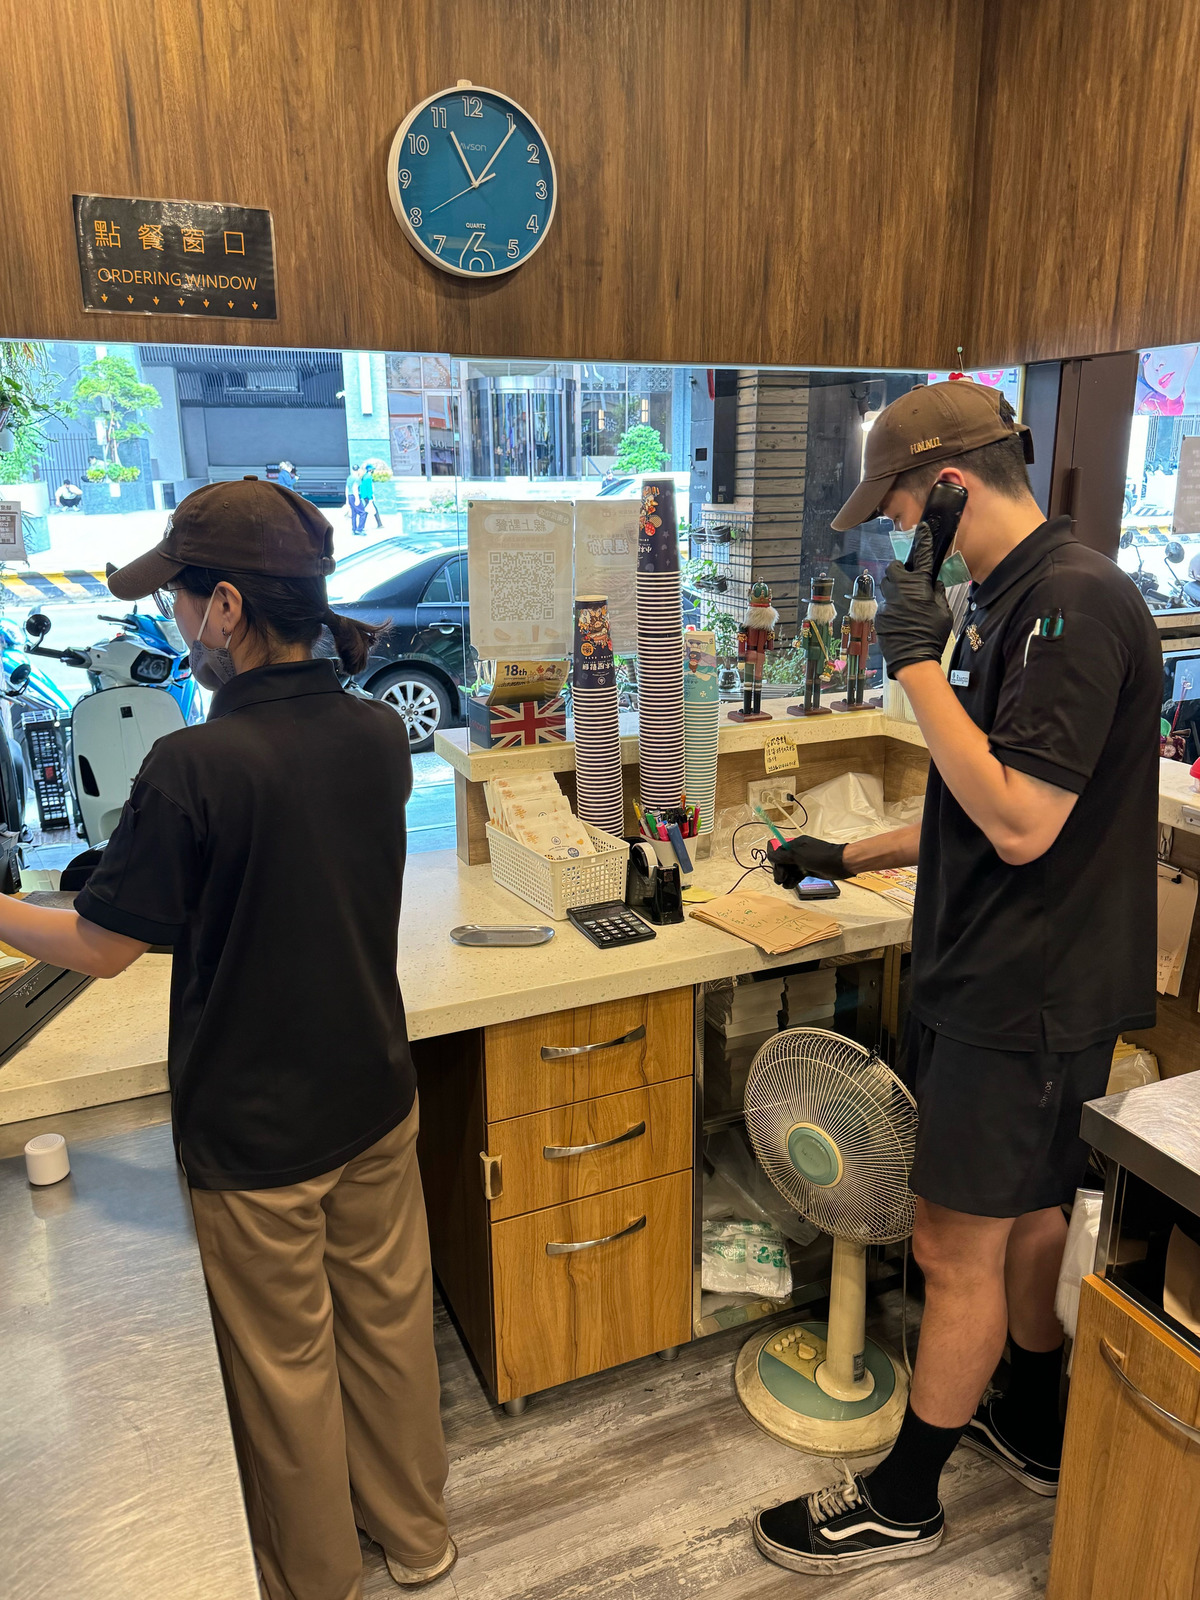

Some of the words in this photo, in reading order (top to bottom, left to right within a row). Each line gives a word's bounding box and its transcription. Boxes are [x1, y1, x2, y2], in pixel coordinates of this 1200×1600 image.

[462, 96, 483, 118] 12
[431, 107, 447, 129] 11
[506, 113, 515, 133] 1
[408, 133, 430, 156] 10
[527, 143, 540, 164] 2
[398, 168, 412, 189] 9
[535, 180, 548, 200] 3
[409, 207, 423, 228] 8
[465, 222, 487, 230] QUARTZ
[526, 214, 540, 234] 4
[94, 219, 246, 256] 點餐窗口
[433, 234, 447, 255] 7
[459, 231, 496, 272] 6
[506, 239, 520, 259] 5
[97, 267, 182, 287] ORDERING
[184, 272, 258, 291] WINDOW
[503, 664, 528, 677] 18th
